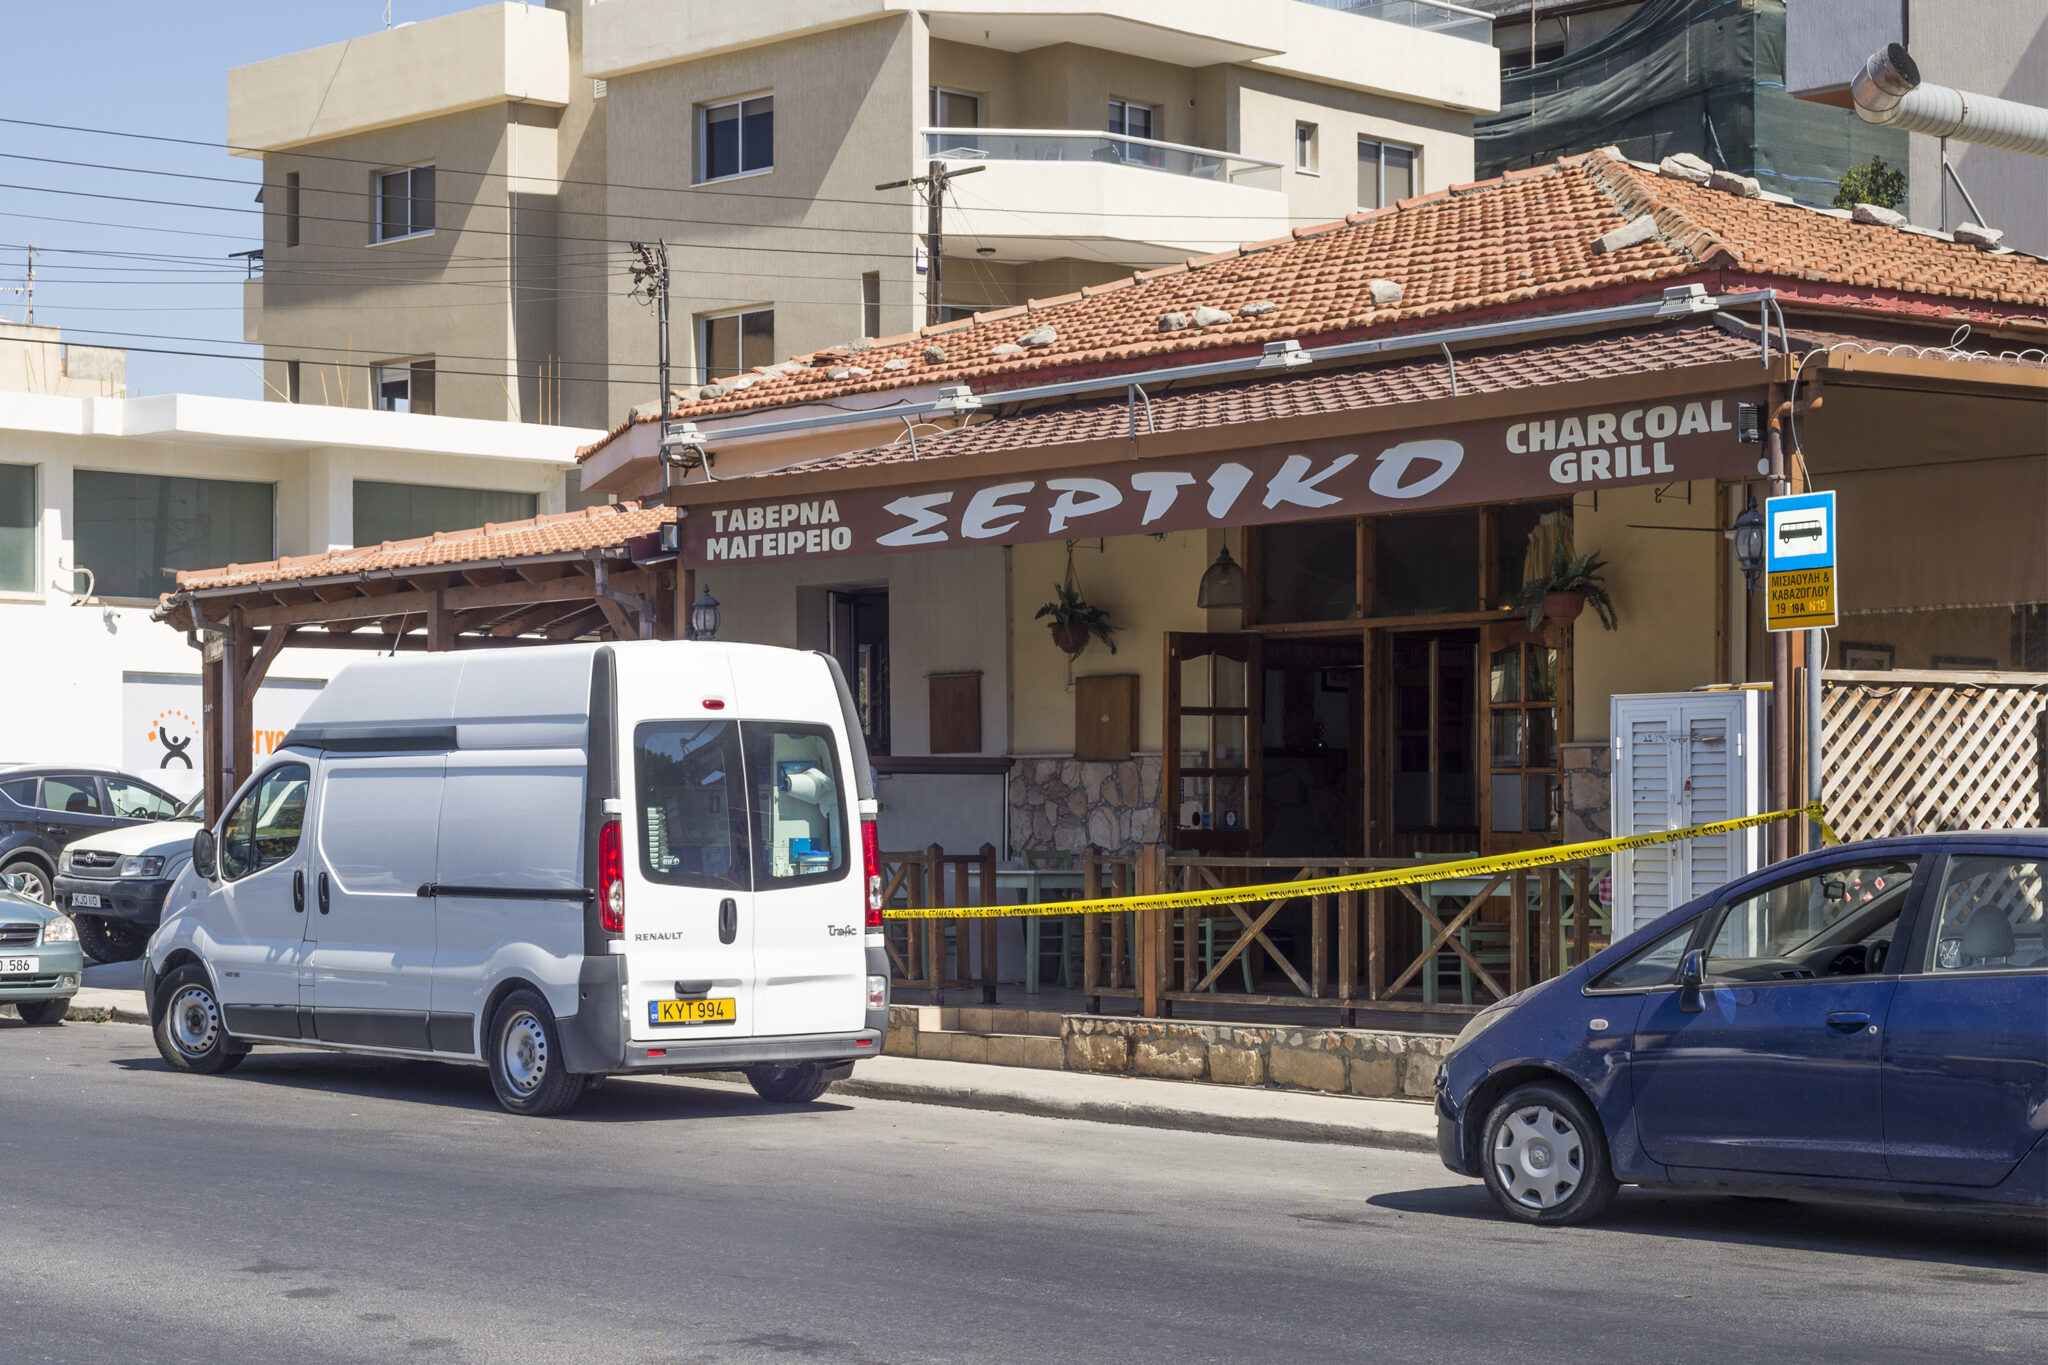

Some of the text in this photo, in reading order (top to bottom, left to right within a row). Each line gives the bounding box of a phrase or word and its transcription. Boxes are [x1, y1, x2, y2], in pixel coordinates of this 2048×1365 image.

[1505, 400, 1732, 454] CHARCOAL
[1549, 441, 1675, 484] GRILL
[875, 439, 1465, 547] ΣΕΡΤΙΚΟ
[711, 499, 841, 533] ΤΑΒΕΡΝΑ
[706, 526, 852, 561] ΜΑΓΕΙΡΕΙΟ
[1771, 571, 1830, 587] ΜΙΣΙΑΟΥΛΗ &
[1771, 585, 1830, 601] ΚΑΒΑΖΟΓΛΟΥ
[1775, 602, 1786, 614] 19
[1790, 602, 1806, 614] 19A
[634, 931, 684, 942] RENAULT
[827, 924, 858, 938] Trafic
[9, 959, 30, 971] 586
[663, 1001, 724, 1019] KYT 994
